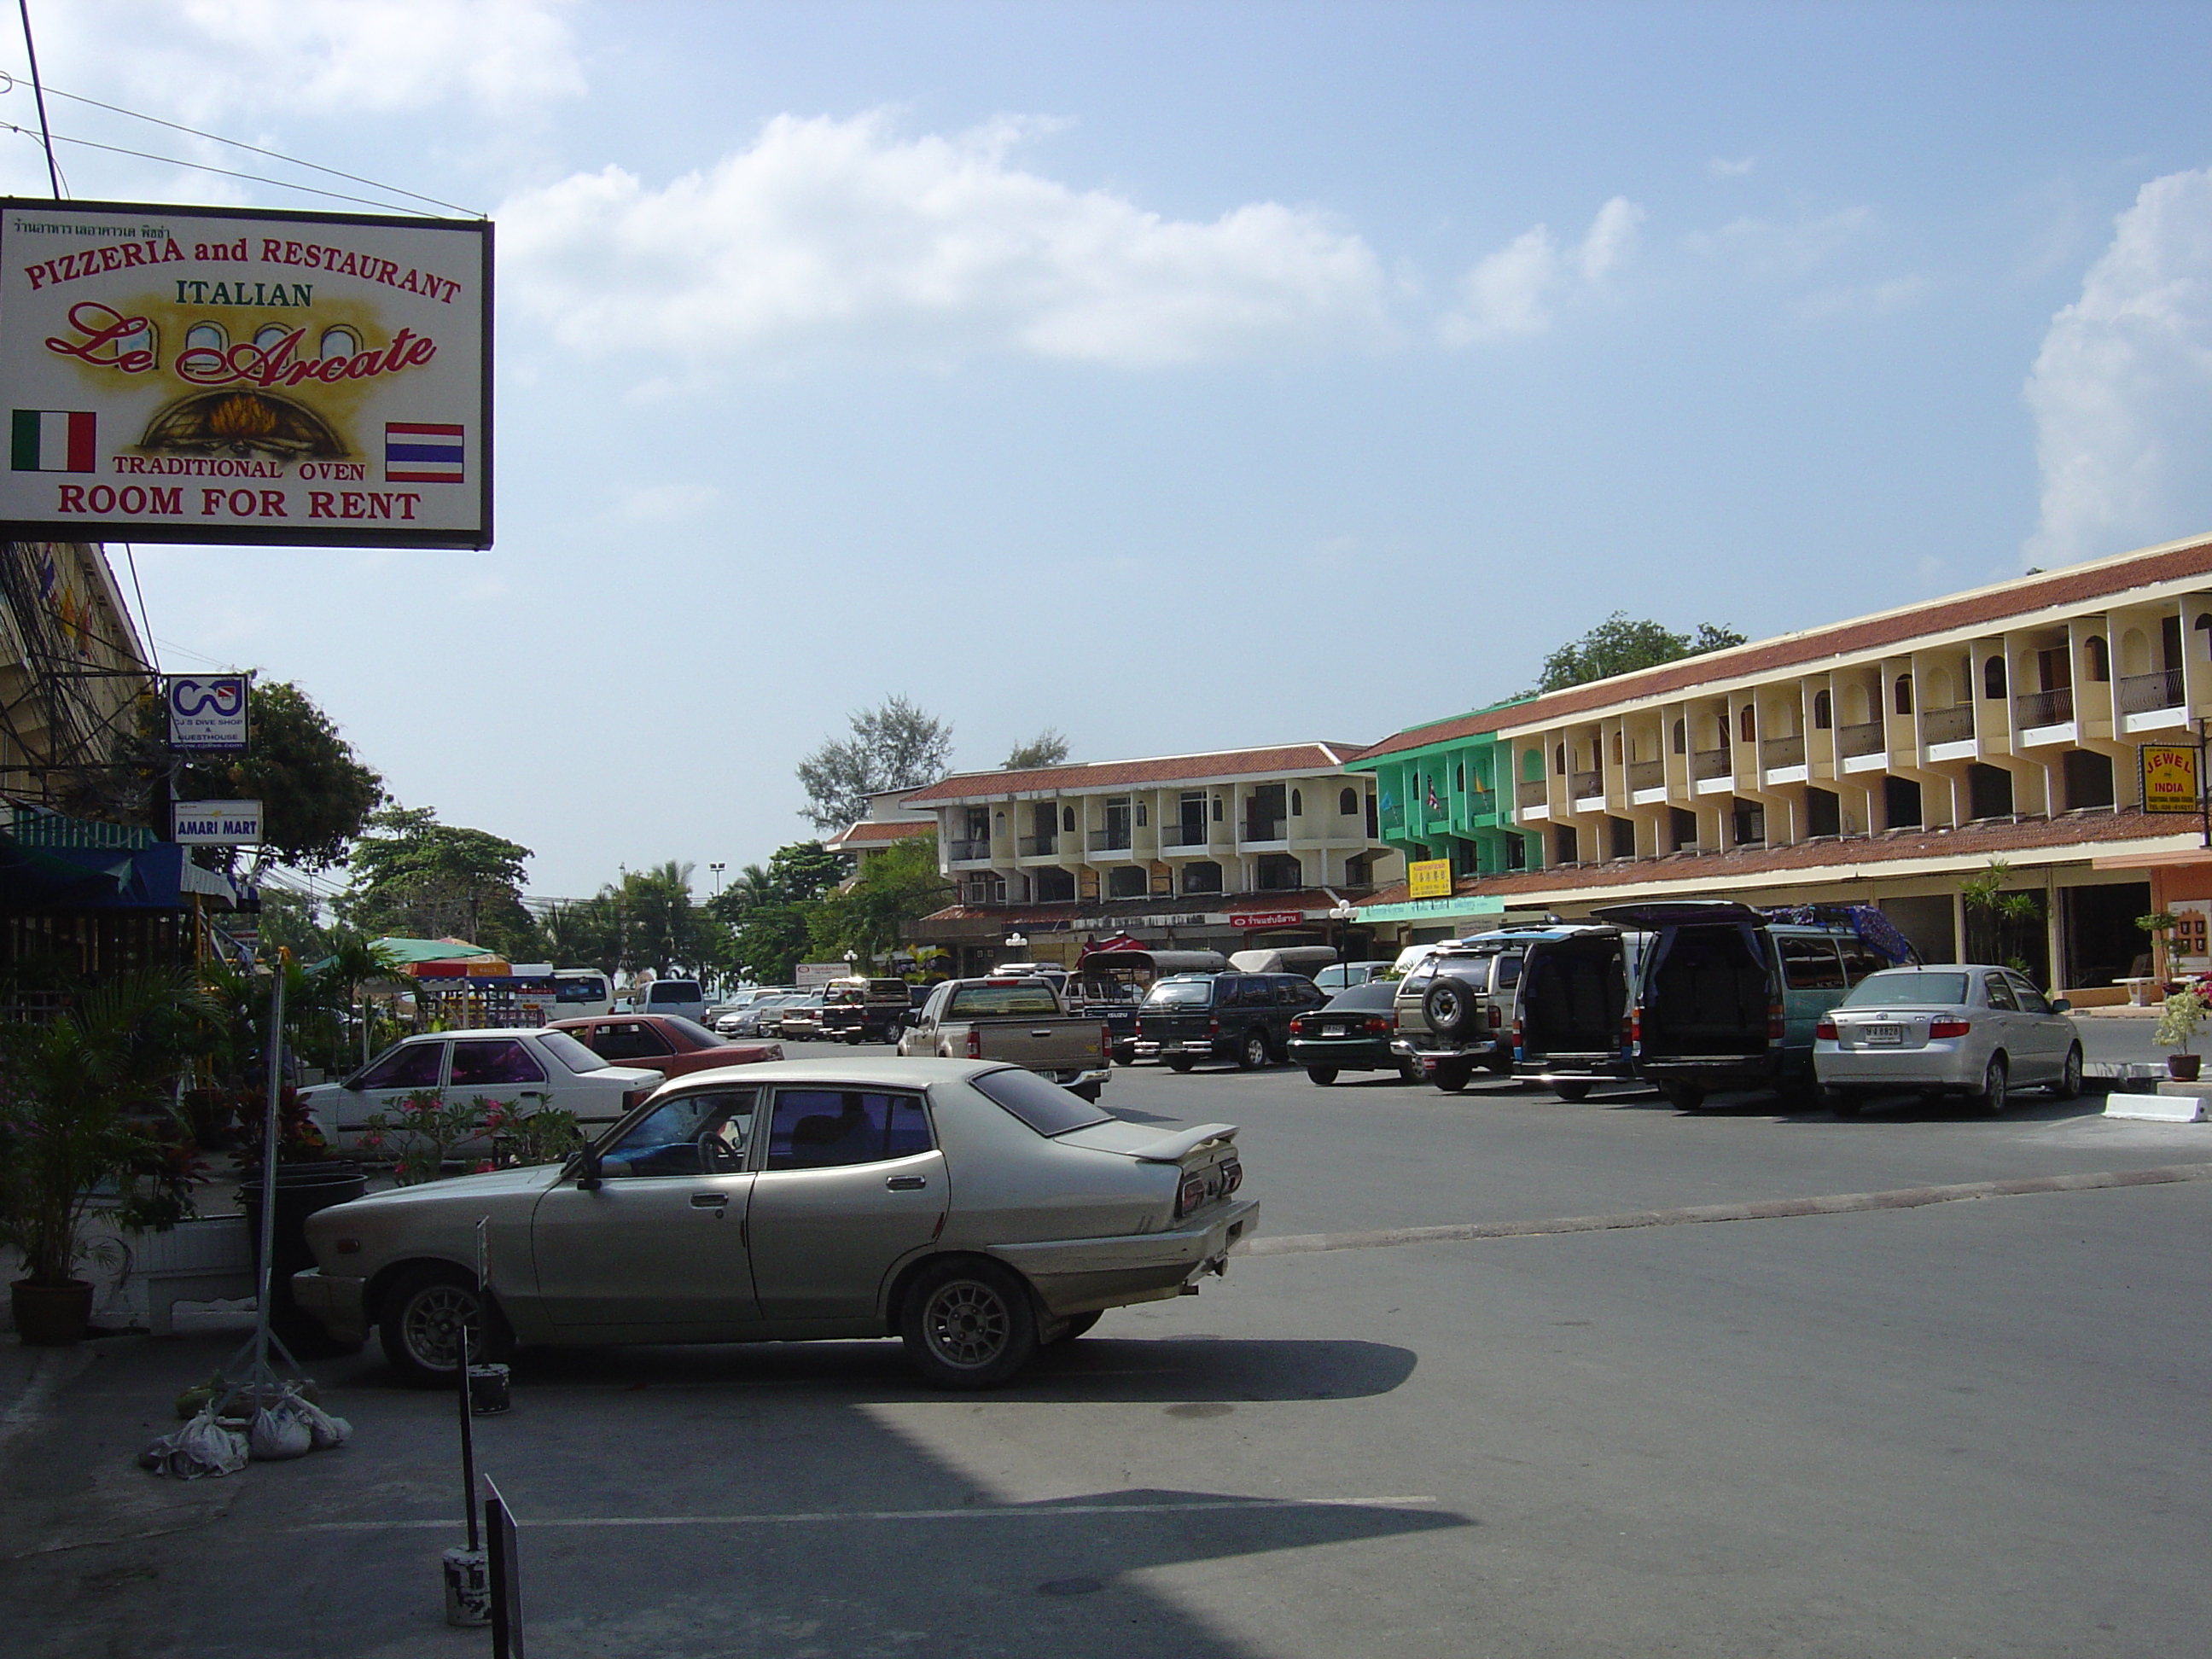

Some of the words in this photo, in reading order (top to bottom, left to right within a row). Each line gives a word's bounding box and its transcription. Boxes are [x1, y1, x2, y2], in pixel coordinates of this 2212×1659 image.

[14, 218, 73, 235] ร้านอาหาร
[24, 238, 185, 290] PIZZERIA
[195, 238, 247, 262] and
[261, 239, 461, 304] RESTAURANT
[175, 280, 313, 307] ITALIAN
[45, 301, 154, 374] Le
[175, 326, 439, 387] Arcate
[113, 456, 284, 479] TRADITIONAL
[299, 463, 365, 480] OVEN
[58, 485, 183, 515] ROOM
[201, 489, 288, 517] FOR
[308, 492, 420, 520] RENT
[2147, 753, 2191, 774] JEWEL
[2155, 783, 2184, 793] INDIA
[178, 821, 218, 835] AMARI
[223, 821, 256, 835] MART
